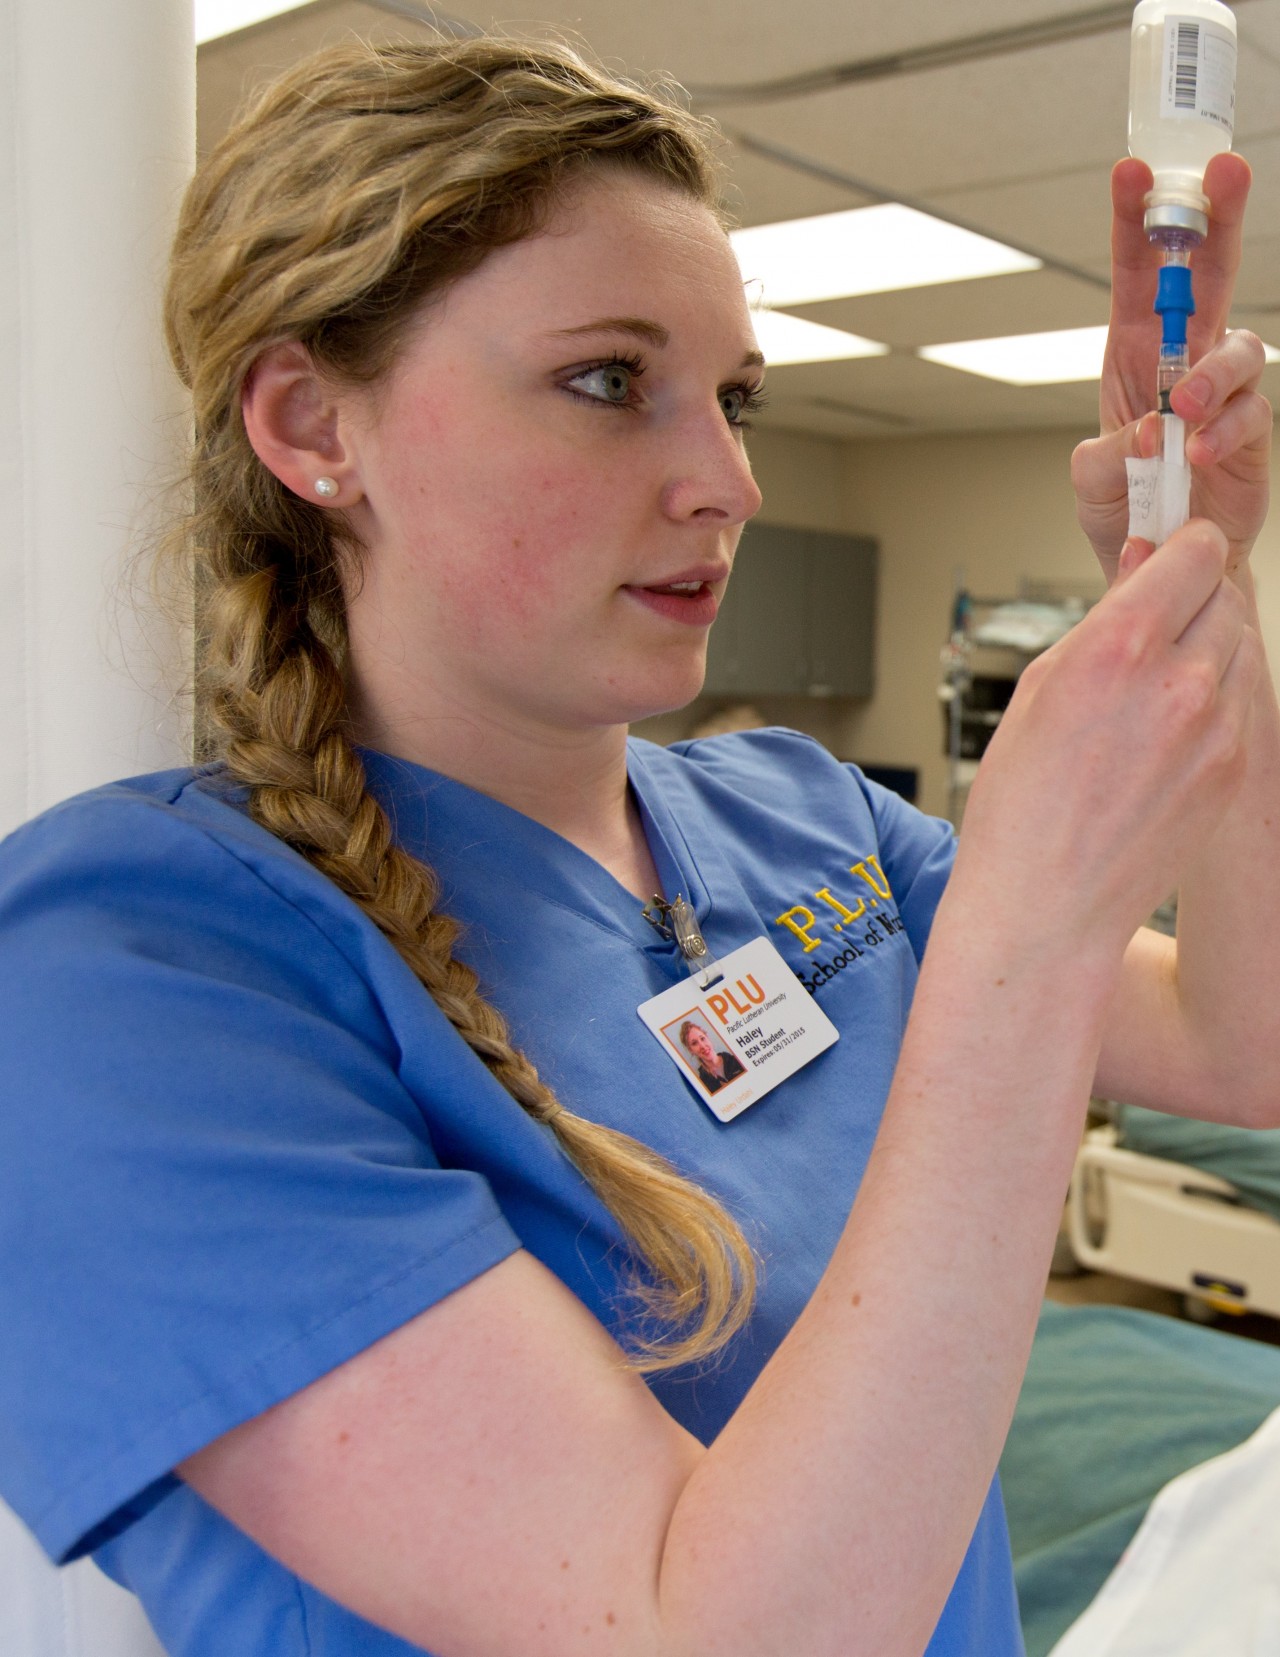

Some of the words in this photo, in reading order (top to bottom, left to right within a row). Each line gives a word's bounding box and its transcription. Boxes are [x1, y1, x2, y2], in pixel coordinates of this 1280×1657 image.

[796, 939, 864, 996] School
[864, 920, 884, 946] of
[705, 973, 766, 1026] PLU
[726, 1020, 744, 1035] Pacific
[742, 1007, 765, 1025] Lutheran
[763, 992, 787, 1011] University
[735, 1026, 764, 1048] Haley
[744, 1044, 761, 1059] BSN
[759, 1027, 787, 1049] Student
[752, 1049, 775, 1067] Expires:
[773, 1026, 806, 1052] 05/31/2015
